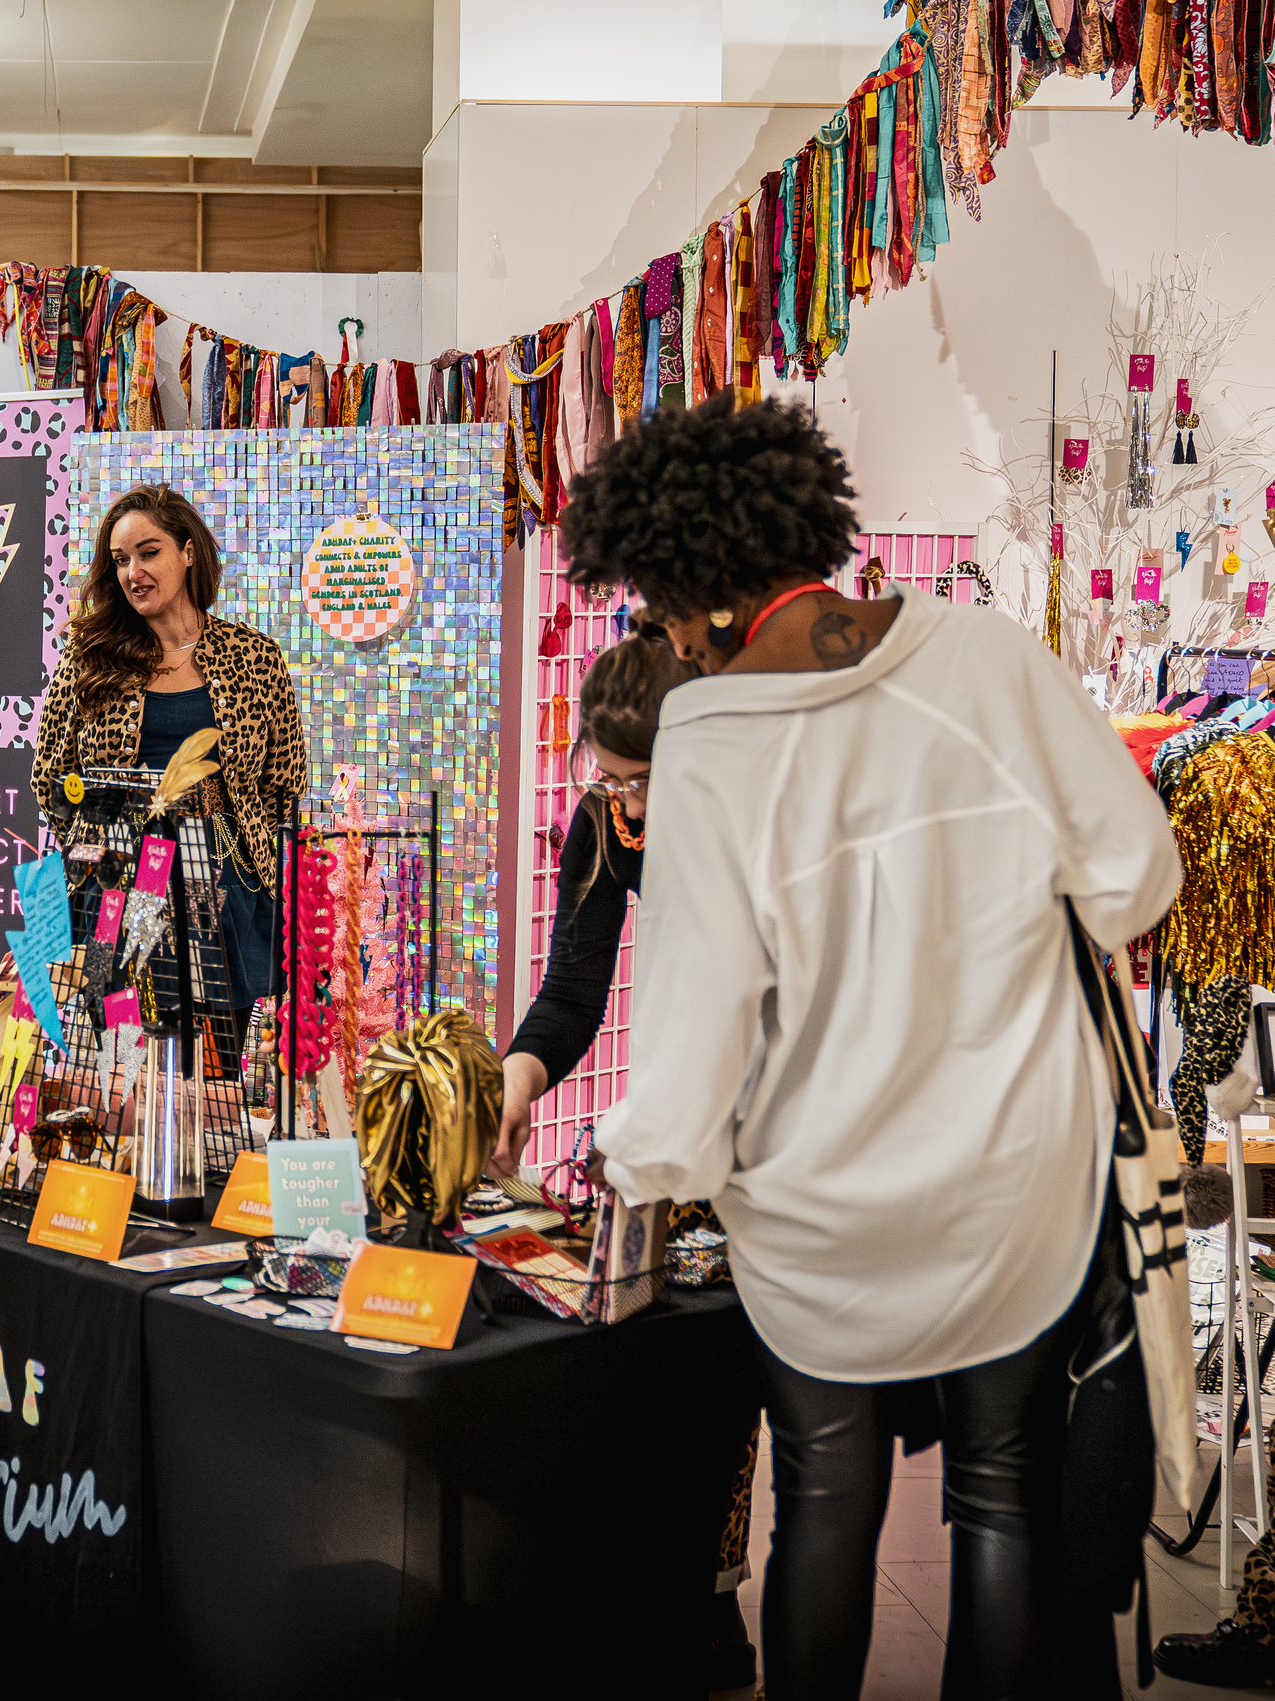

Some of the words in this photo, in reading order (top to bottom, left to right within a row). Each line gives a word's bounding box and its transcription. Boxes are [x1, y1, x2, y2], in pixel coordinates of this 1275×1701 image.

[359, 537, 395, 545] CHARITY
[315, 553, 352, 561] CONNECTS
[354, 551, 361, 560] &
[363, 551, 402, 560] EMPOWERS
[324, 564, 346, 574] ADHD
[347, 564, 377, 573] ADULTS
[379, 564, 389, 572] OF
[326, 577, 385, 586] MARGINALISED
[311, 590, 346, 599] GENDERS
[348, 590, 357, 599] IN
[321, 603, 356, 611] ENGLAND
[358, 602, 365, 610] &
[367, 601, 392, 610] WALES
[280, 1157, 307, 1172] You
[312, 1160, 336, 1170] are
[281, 1176, 340, 1192] tougher
[296, 1194, 329, 1208] than
[297, 1215, 331, 1230] your
